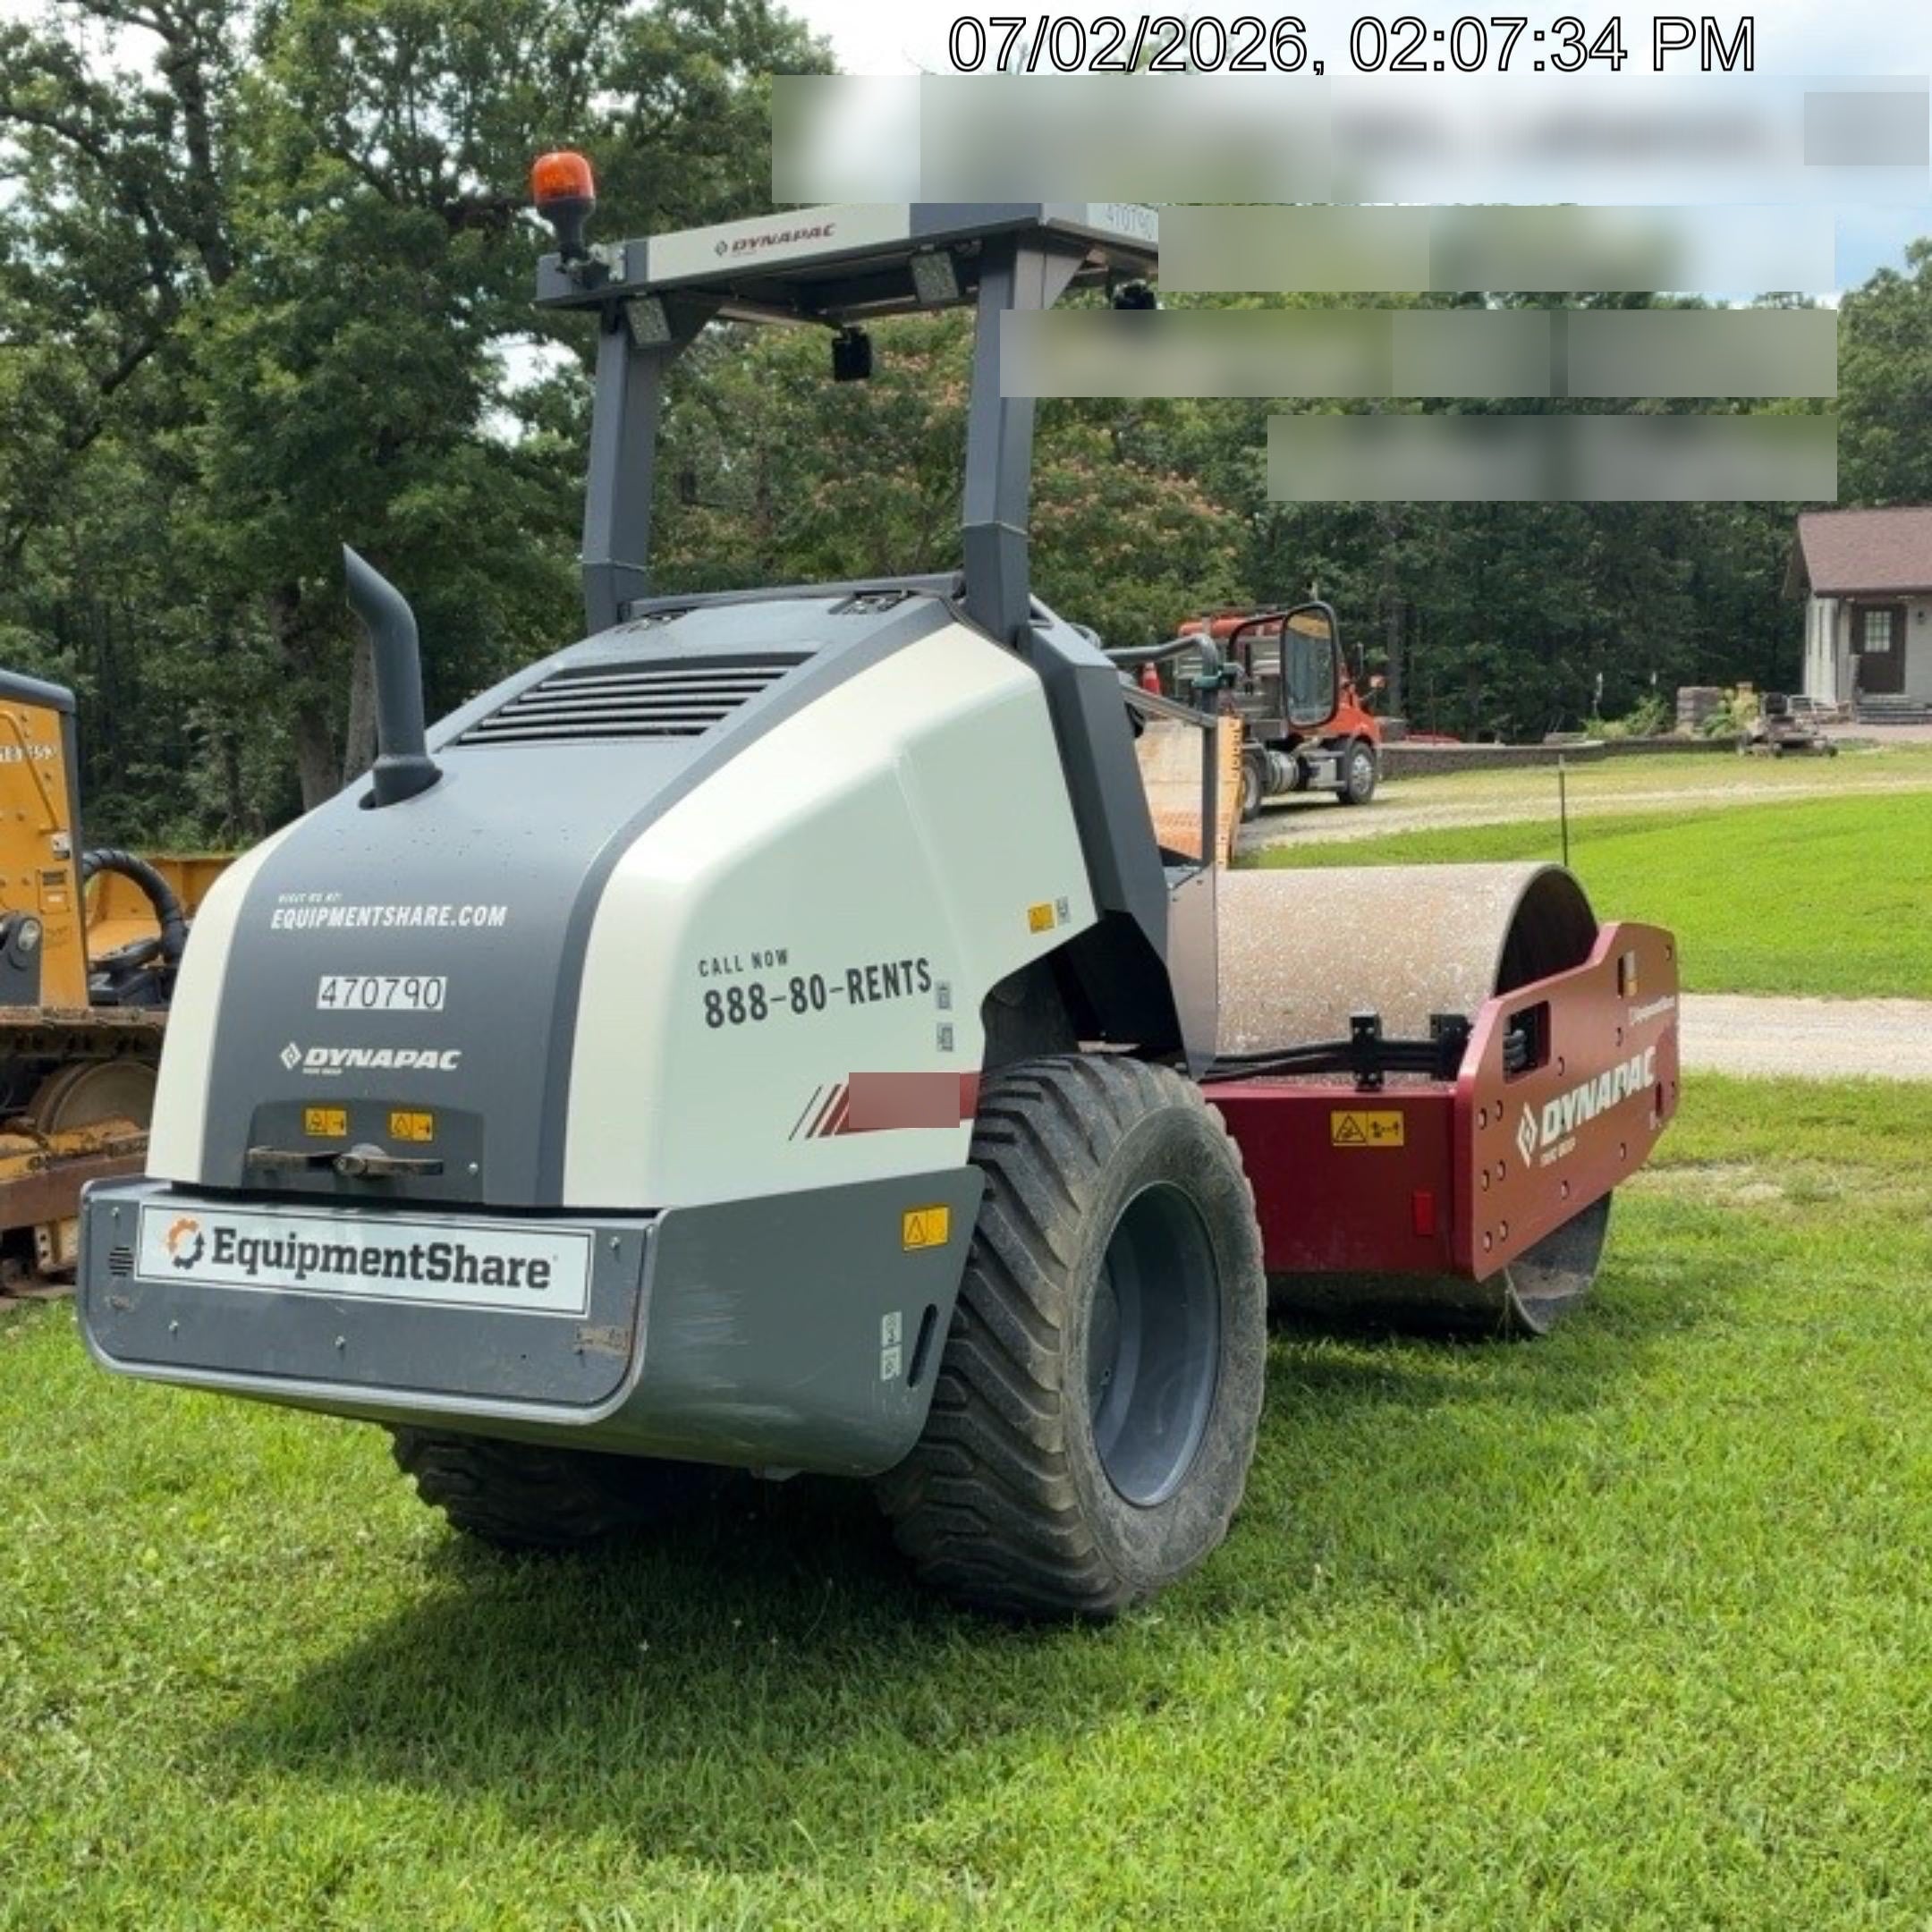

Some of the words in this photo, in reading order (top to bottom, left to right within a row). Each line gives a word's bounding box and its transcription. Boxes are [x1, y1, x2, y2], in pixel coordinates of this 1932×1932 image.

[731, 223, 836, 252] DYNAPAC
[270, 905, 508, 929] EQUIPMENTSHARE.COM
[699, 953, 744, 978] CALL
[751, 948, 789, 970] NOW
[320, 978, 442, 1009] 470790
[703, 957, 933, 1030] 888-80-RENTS
[302, 1047, 462, 1072] DYNAPAC
[1539, 1045, 1657, 1147] DYNAPAC
[211, 1226, 551, 1290] EquipmentShare
